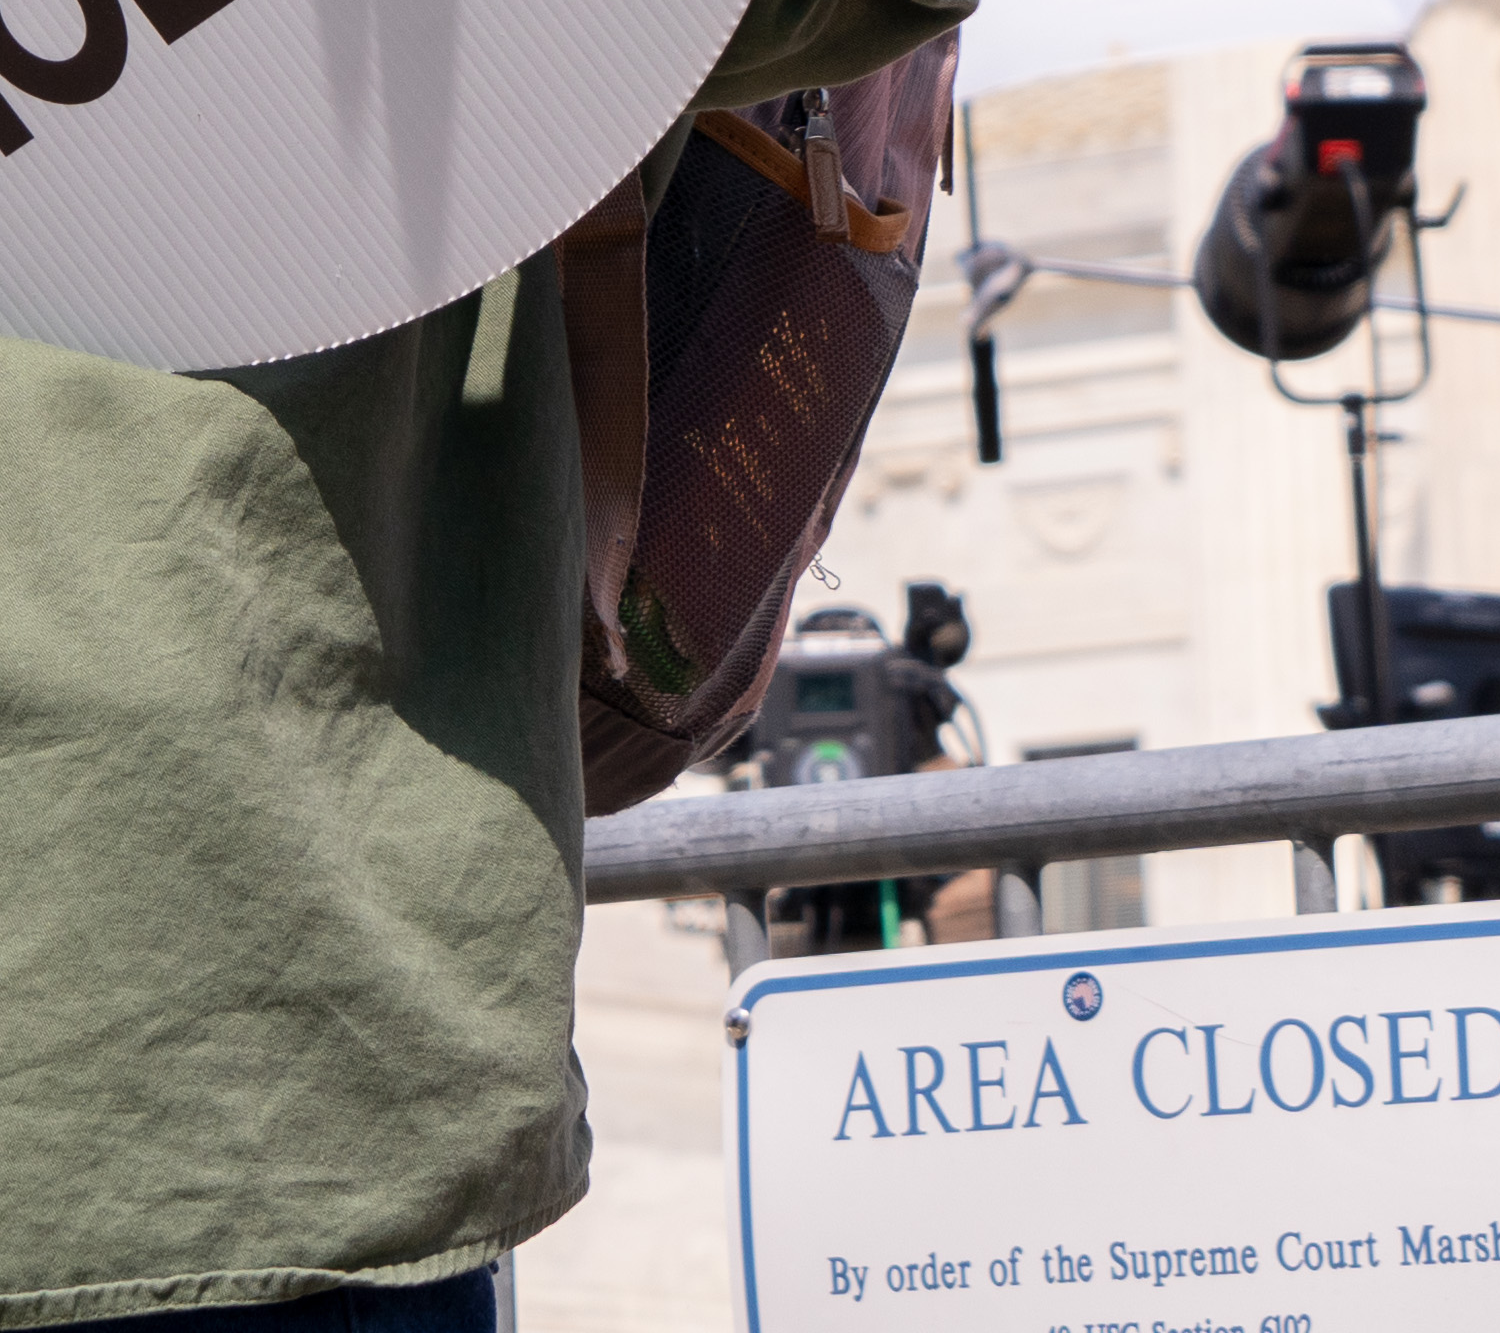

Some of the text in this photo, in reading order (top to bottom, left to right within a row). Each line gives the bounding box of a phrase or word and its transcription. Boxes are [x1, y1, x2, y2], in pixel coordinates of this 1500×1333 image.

[834, 1038, 1089, 1141] AREA
[827, 1256, 870, 1302] By
[887, 1252, 972, 1292] order
[989, 1246, 1023, 1287] of
[1043, 1244, 1094, 1284] the
[1109, 1241, 1259, 1287] Supreme
[1276, 1232, 1380, 1272] Court
